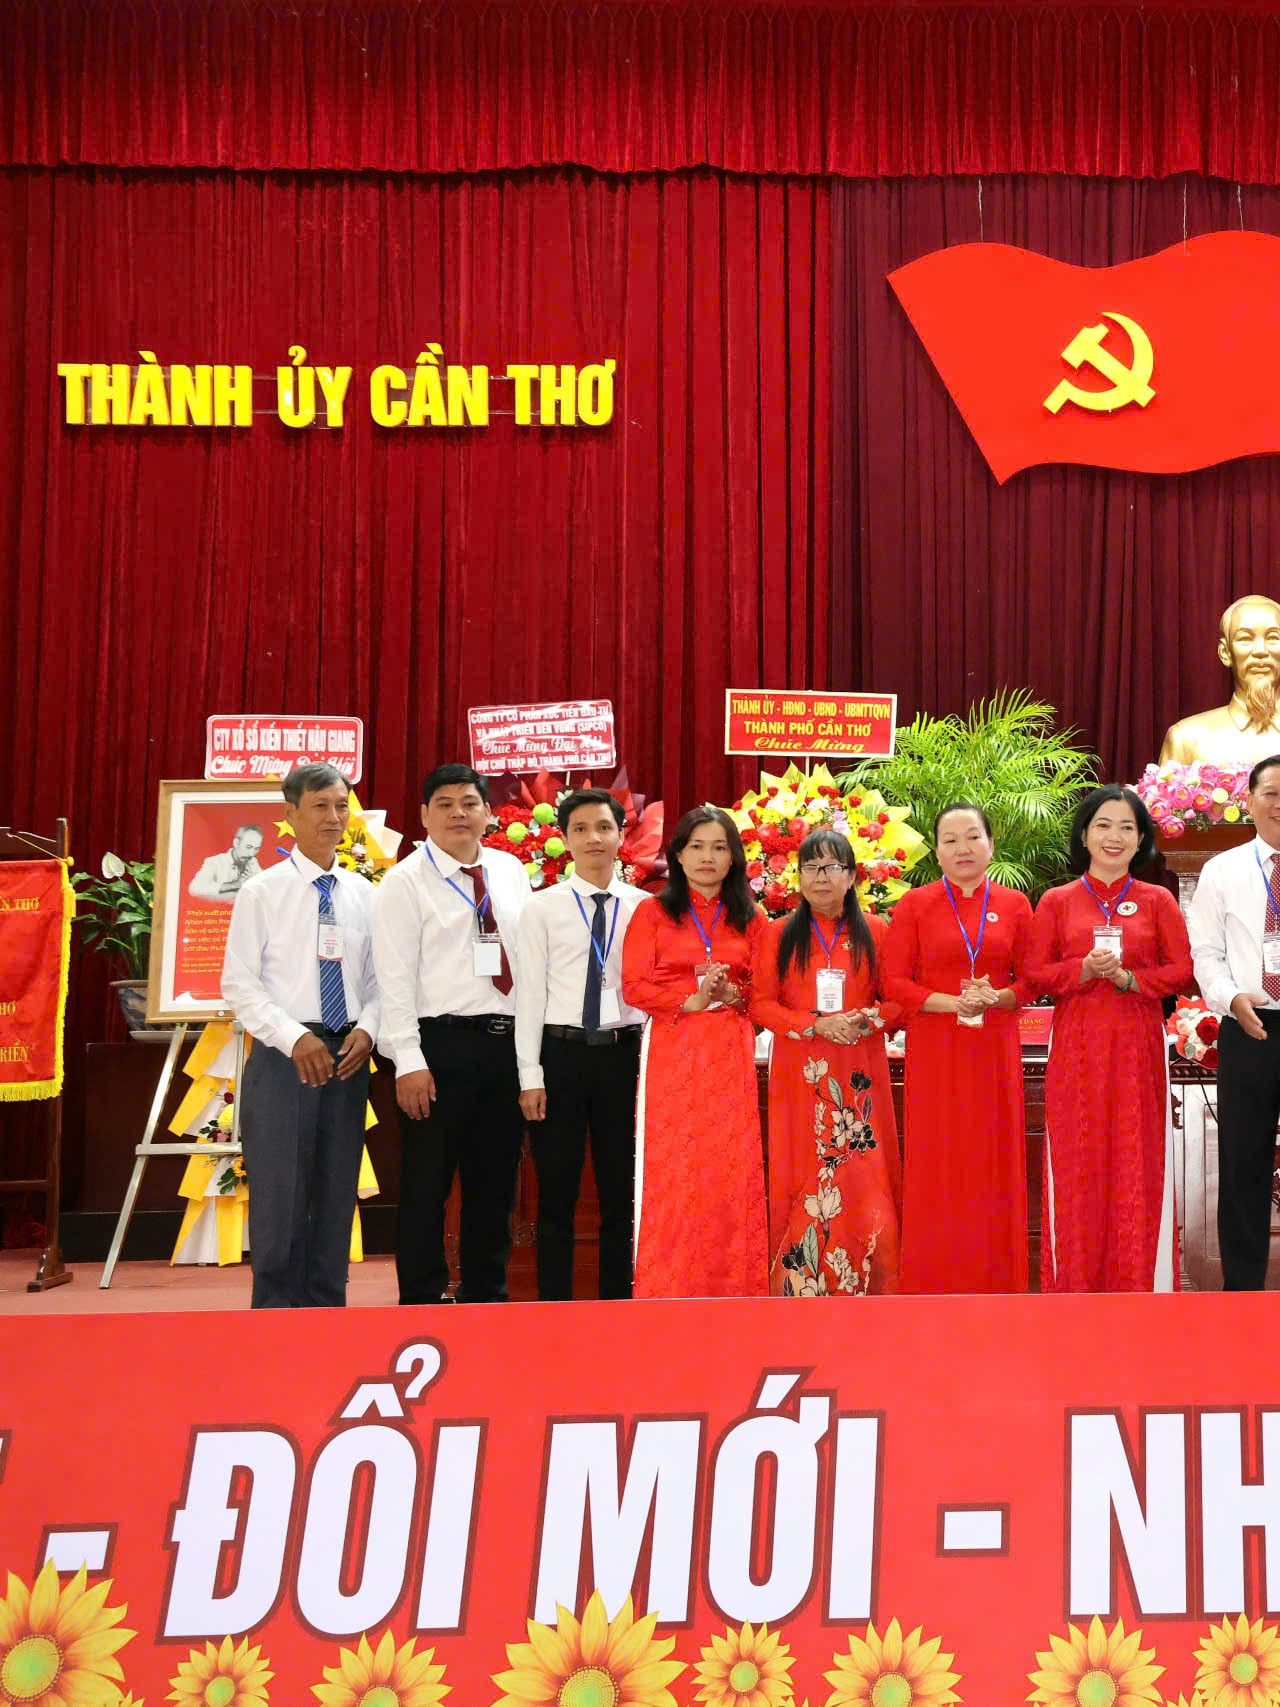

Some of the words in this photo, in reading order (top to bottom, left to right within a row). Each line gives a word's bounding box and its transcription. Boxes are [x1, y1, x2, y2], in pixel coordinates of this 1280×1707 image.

[57, 350, 253, 427] THÀNH
[276, 345, 352, 428] ỦY
[370, 342, 489, 427] CẦN
[506, 358, 616, 427] THƠ
[732, 696, 761, 715] THÀNH
[763, 695, 775, 715] ỦY
[782, 701, 806, 716] HĐND
[813, 701, 837, 717] UBND
[844, 703, 890, 720] UBMTTQVN
[213, 728, 230, 751] CTY
[232, 719, 245, 751] XỔ
[260, 721, 281, 751] KIẾN
[283, 721, 307, 752] THIẾT
[328, 729, 356, 752] GIANG
[744, 718, 785, 735] THÀNH
[789, 718, 815, 735] PHỐ
[817, 718, 842, 736] CẦN
[846, 722, 872, 737] THƠ
[754, 737, 803, 750] Chúc
[806, 738, 865, 753] Mừng
[211, 754, 247, 774] Chúc
[249, 755, 293, 779] Mừng
[15, 896, 39, 910] THƠ
[160, 1339, 485, 1641] ĐỔI
[533, 1370, 883, 1626] MỚI
[940, 1507, 1006, 1553] -
